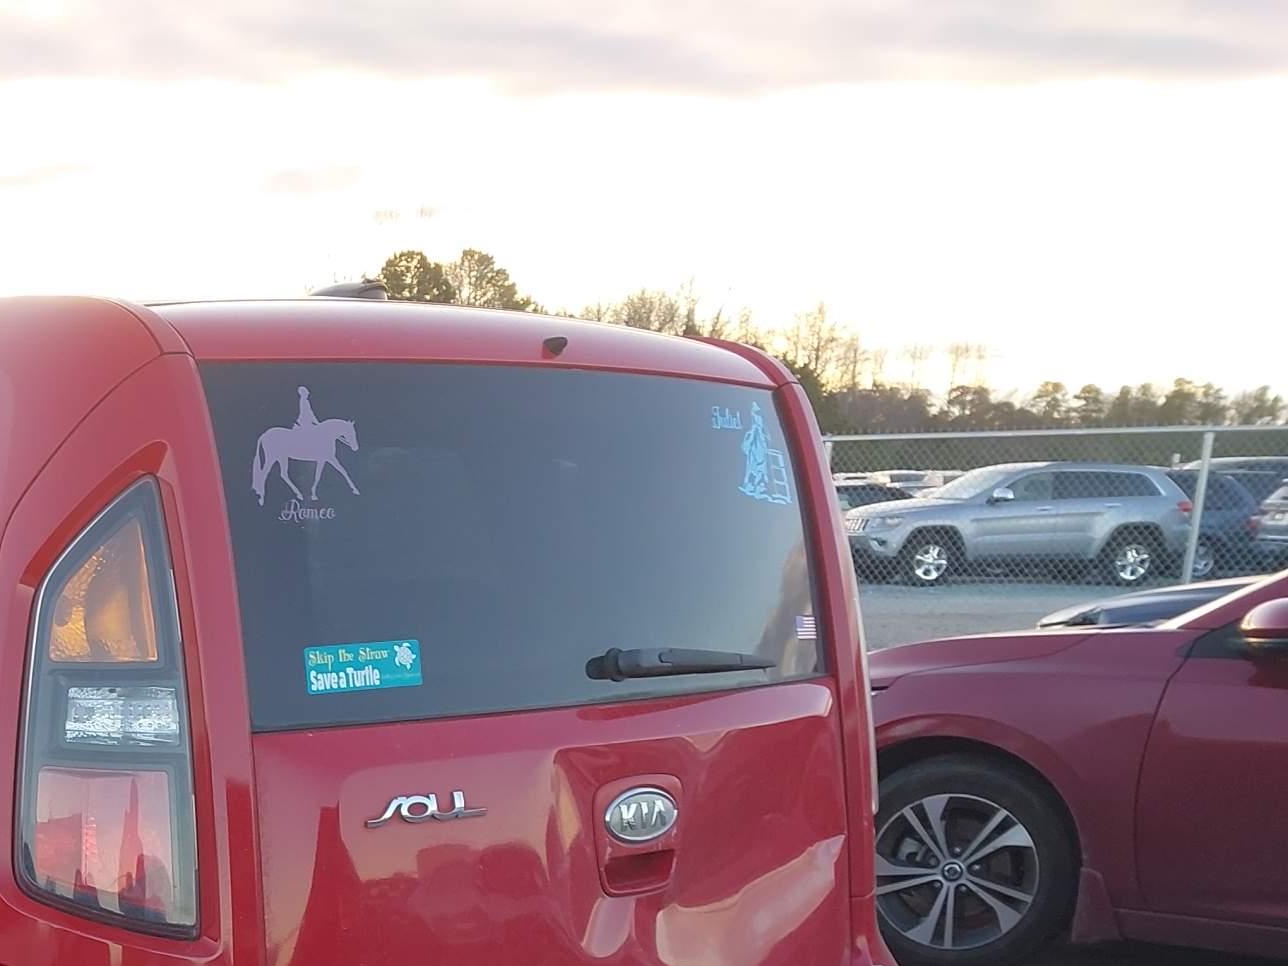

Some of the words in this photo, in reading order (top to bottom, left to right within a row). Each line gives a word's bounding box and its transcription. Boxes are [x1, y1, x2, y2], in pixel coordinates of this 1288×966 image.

[278, 499, 336, 523] Romeo
[308, 651, 334, 671] Skip
[338, 649, 354, 662] the
[358, 648, 390, 662] Straw
[310, 669, 339, 691] Save
[338, 671, 347, 688] a
[345, 664, 381, 687] Turtle
[364, 790, 489, 828] SOUL
[618, 799, 667, 832] KIA
